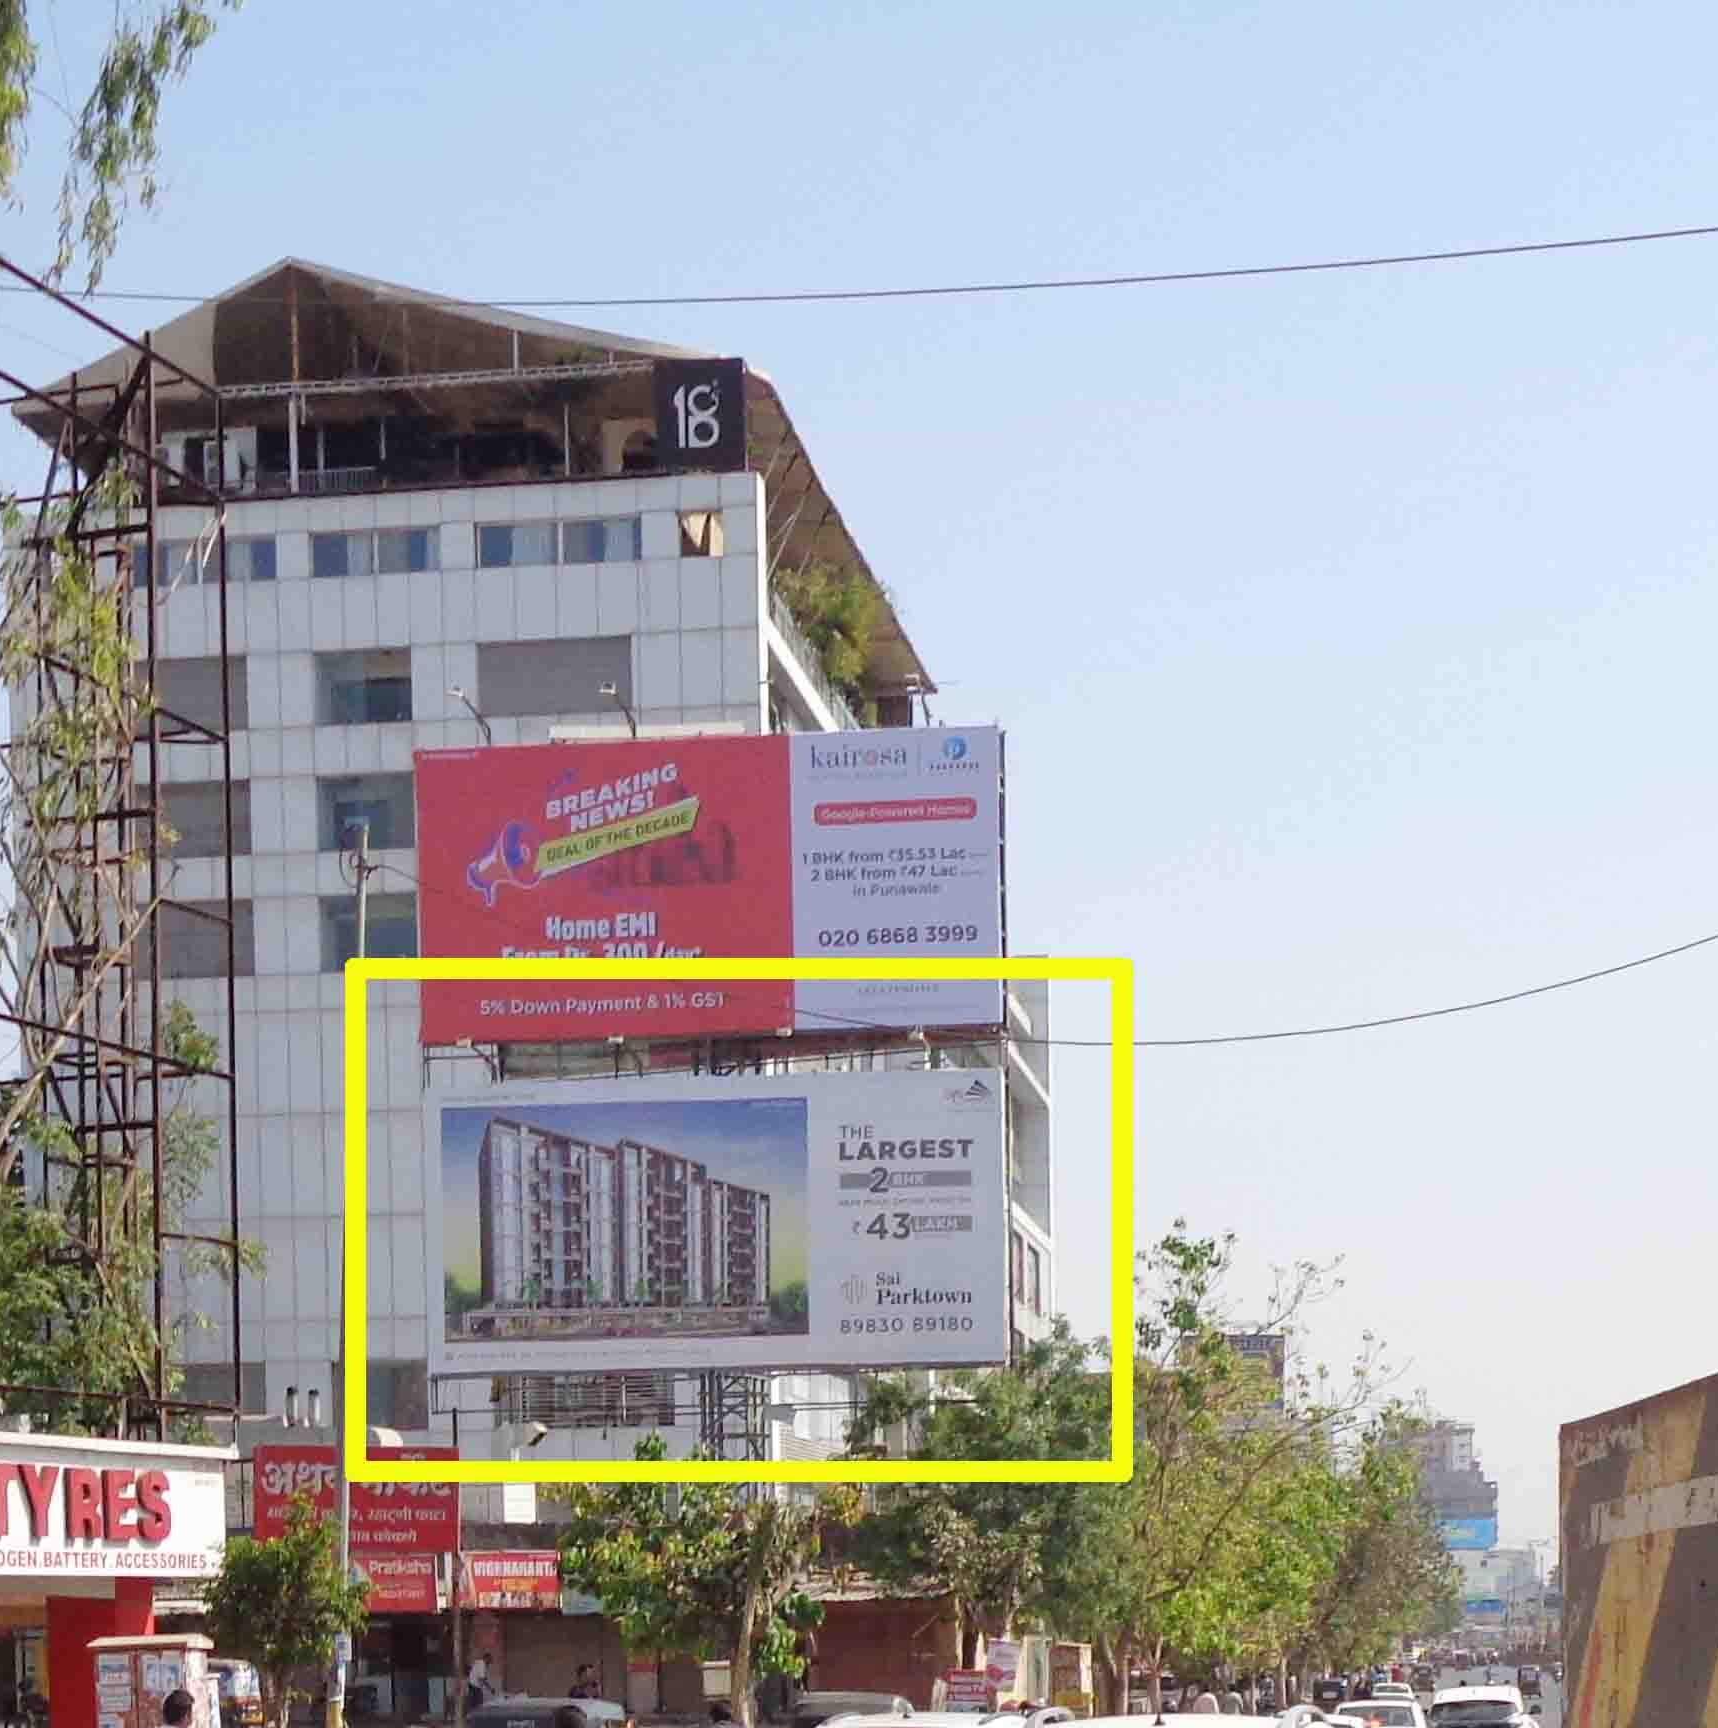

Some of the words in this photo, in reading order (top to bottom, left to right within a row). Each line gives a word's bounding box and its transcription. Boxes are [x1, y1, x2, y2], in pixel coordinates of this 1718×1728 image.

[810, 744, 907, 769] kairosa
[546, 763, 678, 820] BREAKING
[570, 790, 655, 833] NEWS!
[546, 845, 581, 862] DEAL
[585, 833, 605, 850] OF
[607, 827, 633, 843] THE
[635, 810, 689, 838] DECADE
[812, 851, 844, 865] BHK
[848, 848, 884, 862] from
[940, 846, 967, 860] Lac
[810, 870, 820, 883] 2
[824, 868, 859, 881] BHK
[860, 866, 896, 880] from
[545, 915, 610, 941] Home
[615, 911, 657, 938] EMI
[818, 929, 860, 947] 020
[866, 926, 918, 946] 6868
[924, 924, 980, 943] 3999
[480, 999, 505, 1016] 5%
[510, 999, 561, 1016] Down
[566, 995, 643, 1014] Payment
[646, 993, 659, 1009] &
[664, 993, 687, 1009] 1%
[838, 1125, 875, 1139] THE
[838, 1138, 975, 1161] LARGEST
[869, 1166, 890, 1193] 2
[875, 1271, 901, 1286] Sai
[875, 1287, 973, 1305] Parktown
[840, 1317, 904, 1334] 89830
